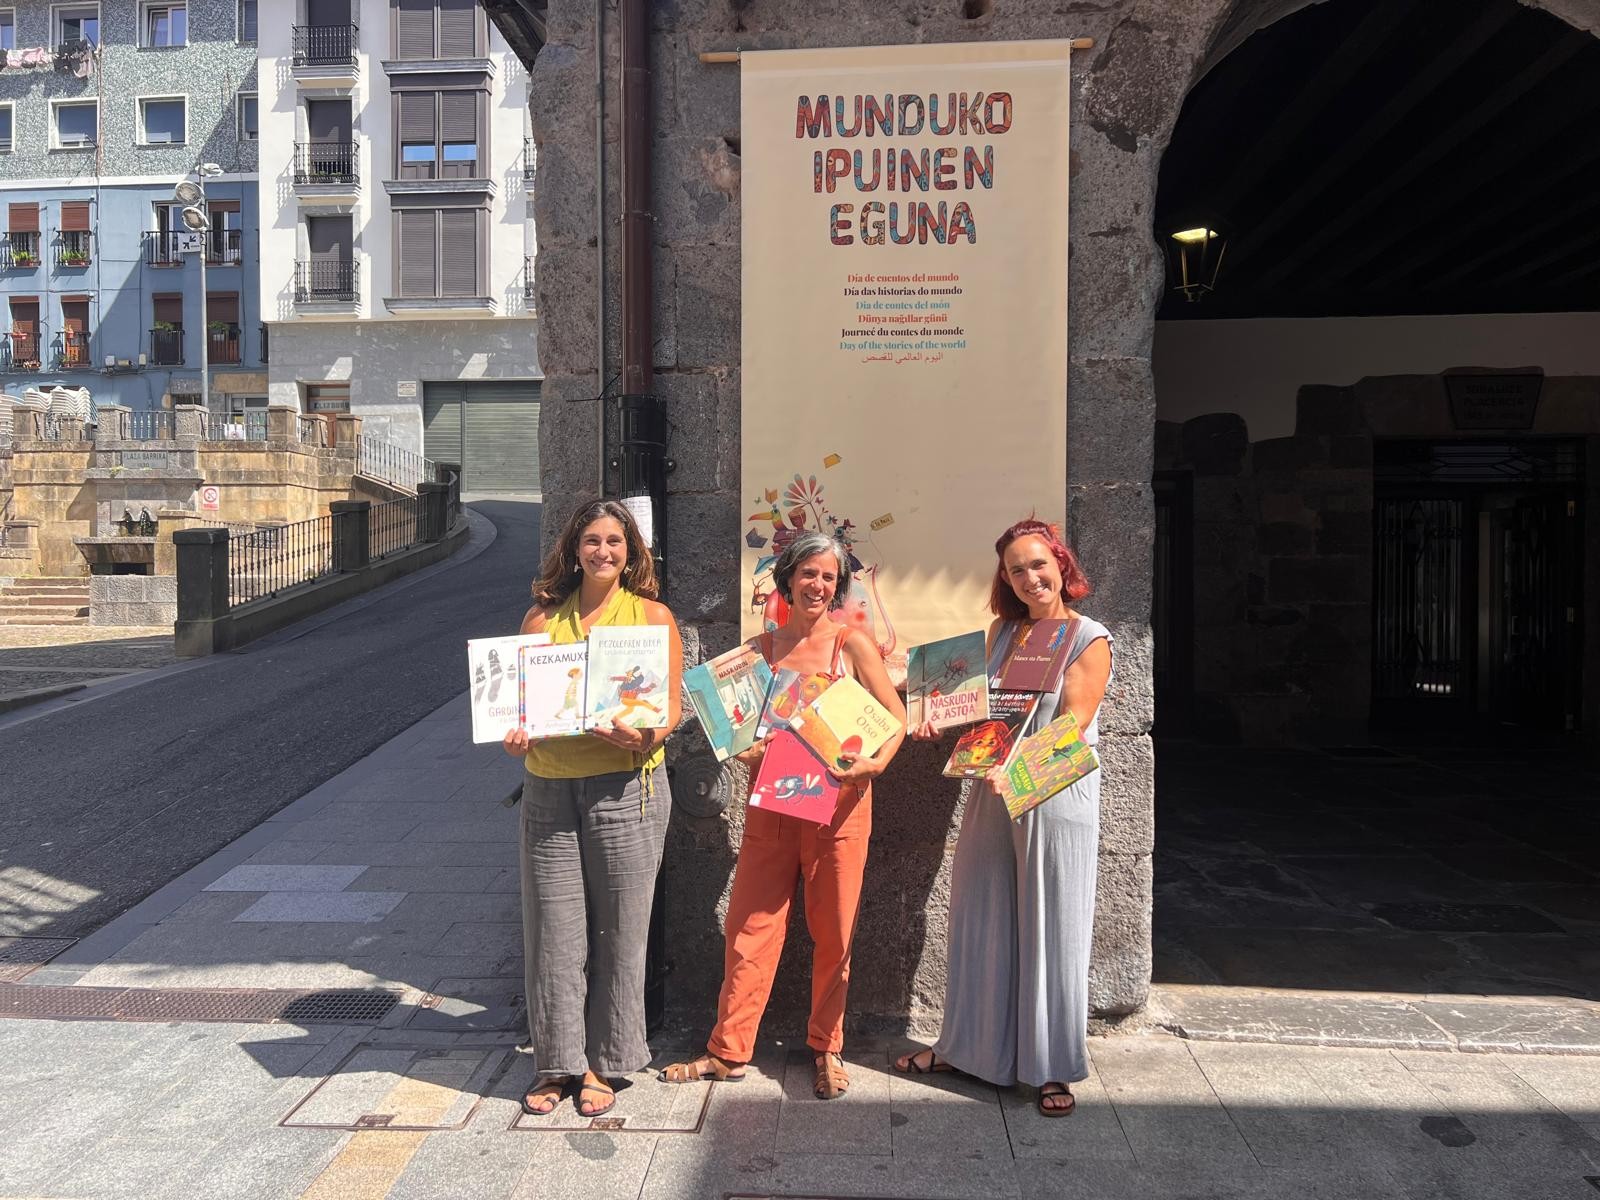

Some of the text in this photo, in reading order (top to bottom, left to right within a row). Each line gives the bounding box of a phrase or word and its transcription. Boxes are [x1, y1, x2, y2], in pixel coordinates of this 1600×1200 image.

[795, 91, 1013, 139] MUNDUKO
[813, 145, 994, 193] IPUINEN
[830, 200, 977, 245] EGUNA
[864, 273, 875, 283] de
[876, 273, 911, 283] cuentos
[912, 273, 926, 282] del
[927, 272, 959, 282] mundo
[861, 287, 876, 296] das
[877, 286, 917, 296] historias
[917, 286, 929, 296] do
[930, 286, 963, 295] mundo
[873, 301, 884, 310] de
[885, 301, 913, 309] contes
[914, 300, 929, 309] del
[930, 299, 950, 309] món
[858, 314, 887, 325] Dünya
[924, 313, 948, 324] günü
[877, 327, 889, 336] du
[890, 327, 919, 336] contes
[920, 327, 932, 336] du
[933, 326, 965, 336] monde
[839, 340, 966, 351] Day of the stories of the world
[930, 691, 979, 710] NASRUDIN
[863, 704, 891, 734] Osaba
[930, 703, 976, 722] & ASTOA
